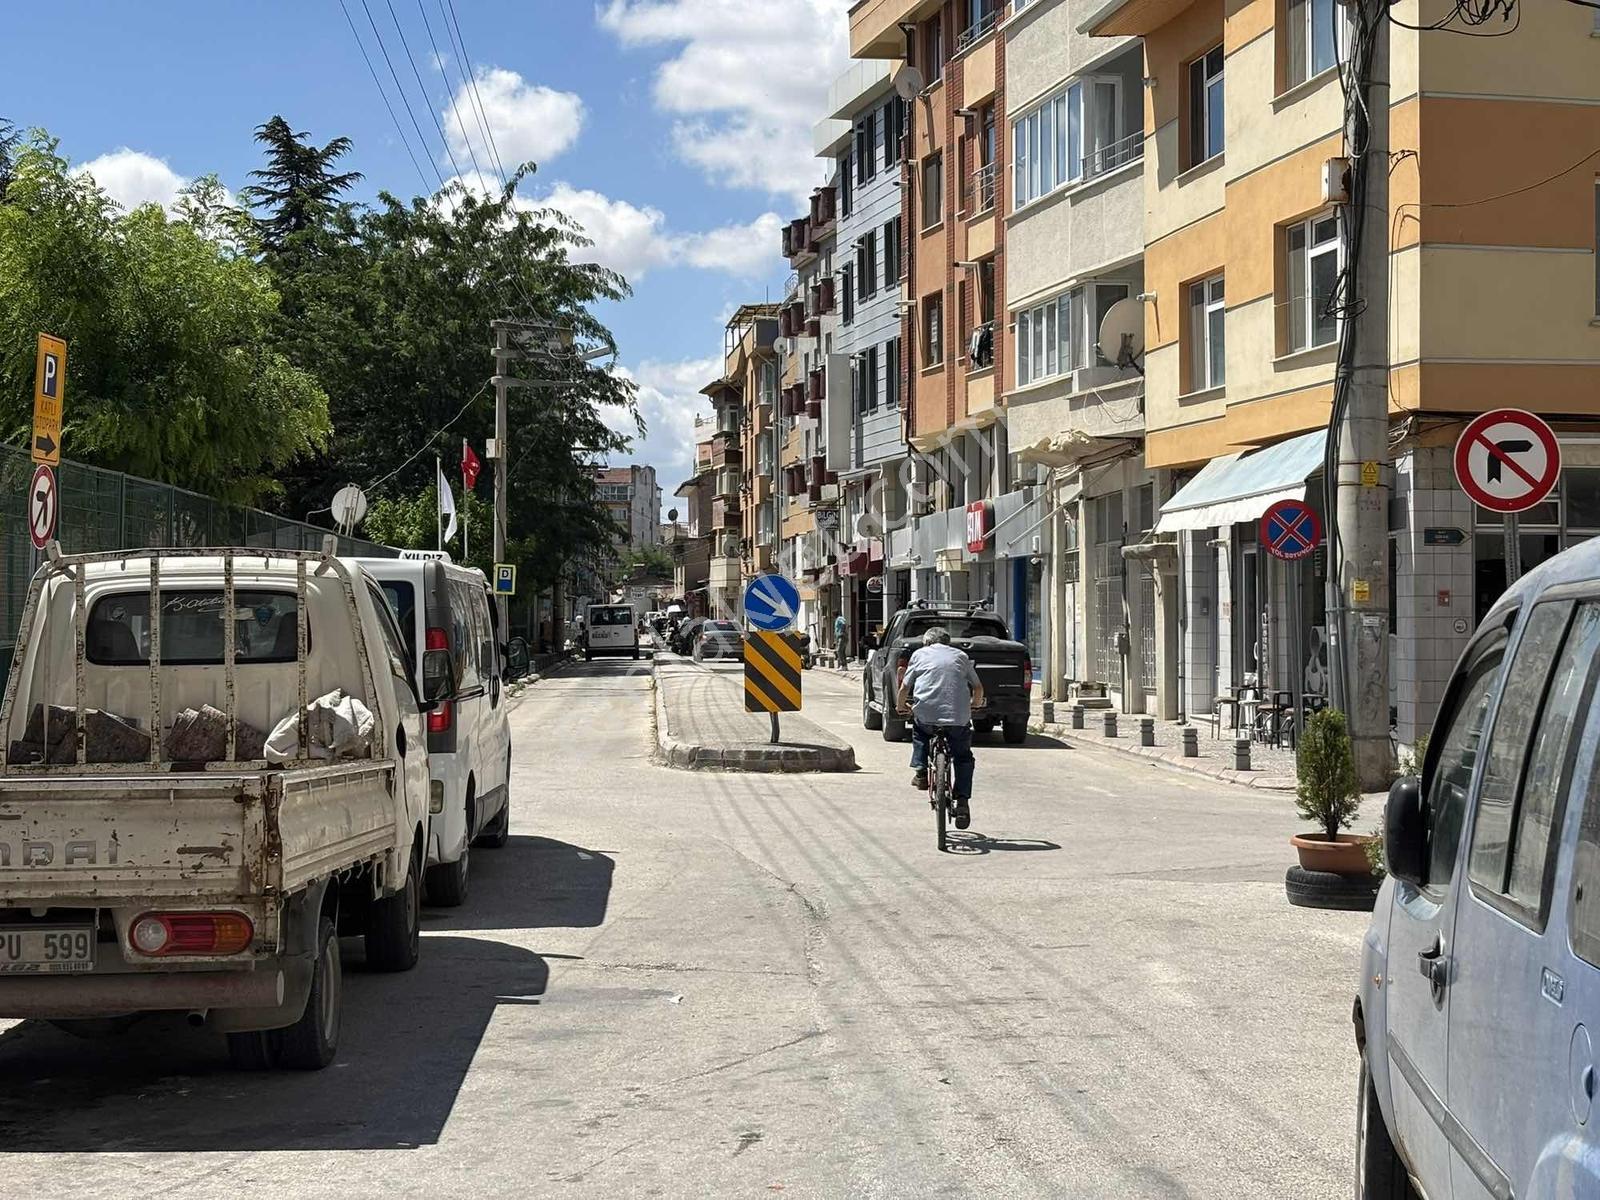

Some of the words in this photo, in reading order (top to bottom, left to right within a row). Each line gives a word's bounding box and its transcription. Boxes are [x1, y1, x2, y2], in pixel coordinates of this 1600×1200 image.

[44, 355, 56, 393] P
[501, 569, 510, 578] D
[44, 933, 88, 960] 599
